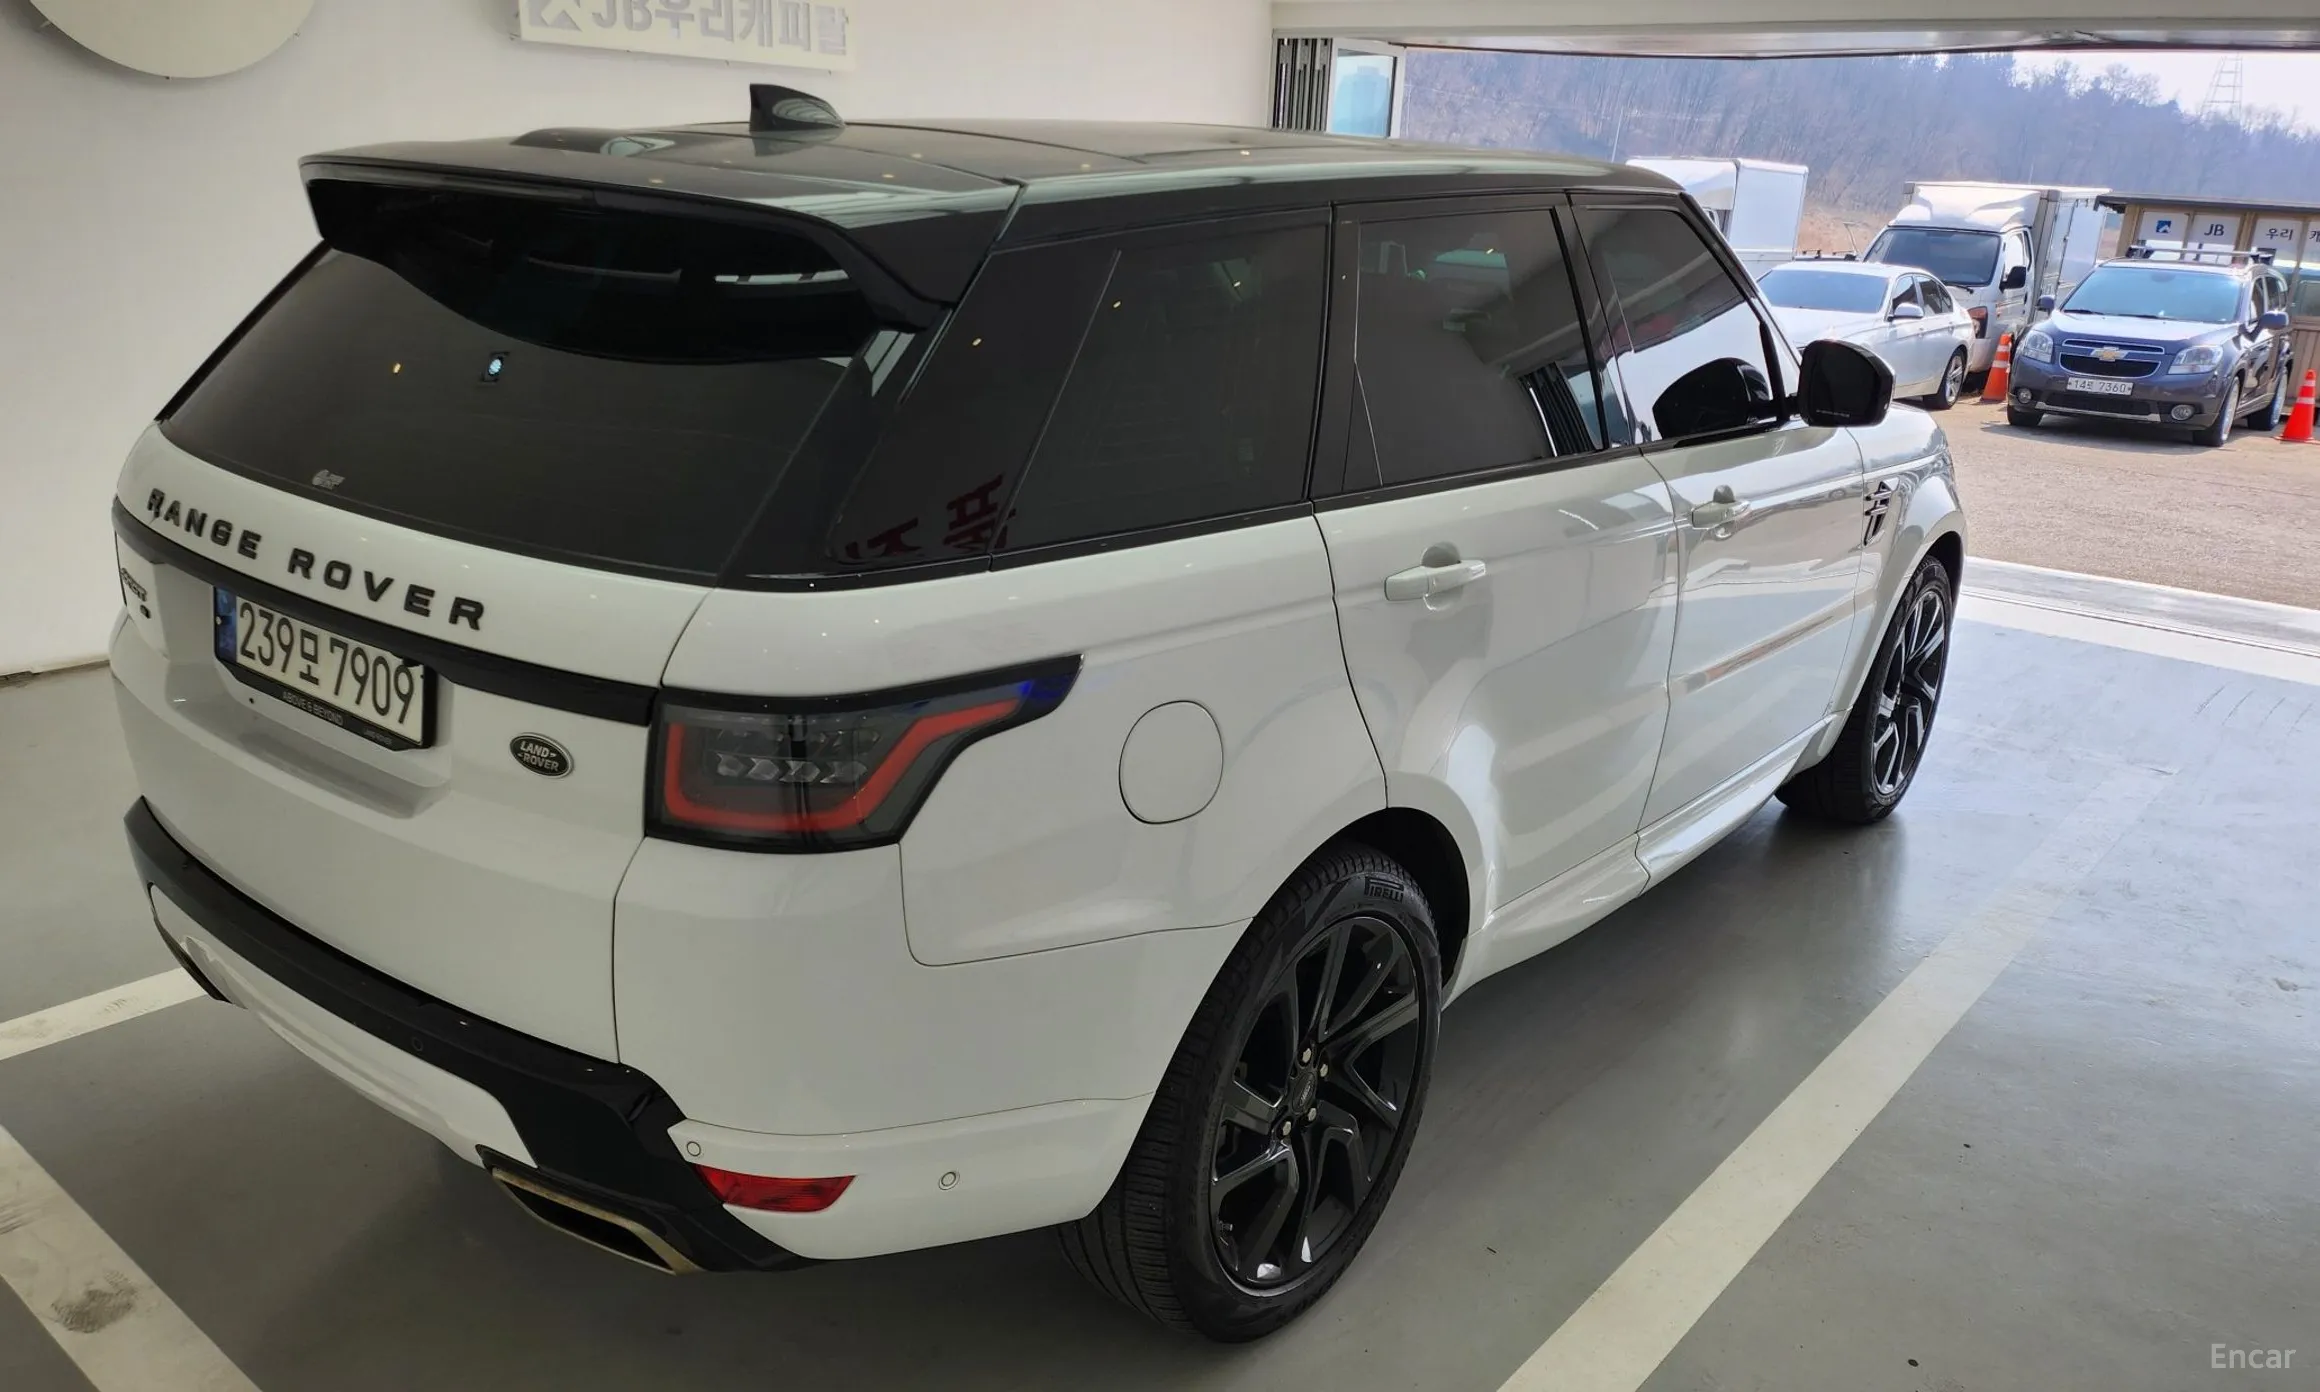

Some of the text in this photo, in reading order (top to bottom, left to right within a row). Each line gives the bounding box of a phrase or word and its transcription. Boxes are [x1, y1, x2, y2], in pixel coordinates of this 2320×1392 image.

[2203, 223, 2225, 237] JB
[2265, 227, 2294, 241] 우리
[2099, 381, 2127, 393] 7360
[147, 487, 485, 632] RANGE ROVER
[329, 636, 415, 725] 7909
[520, 740, 550, 758] LAND
[523, 752, 560, 772] ROVER
